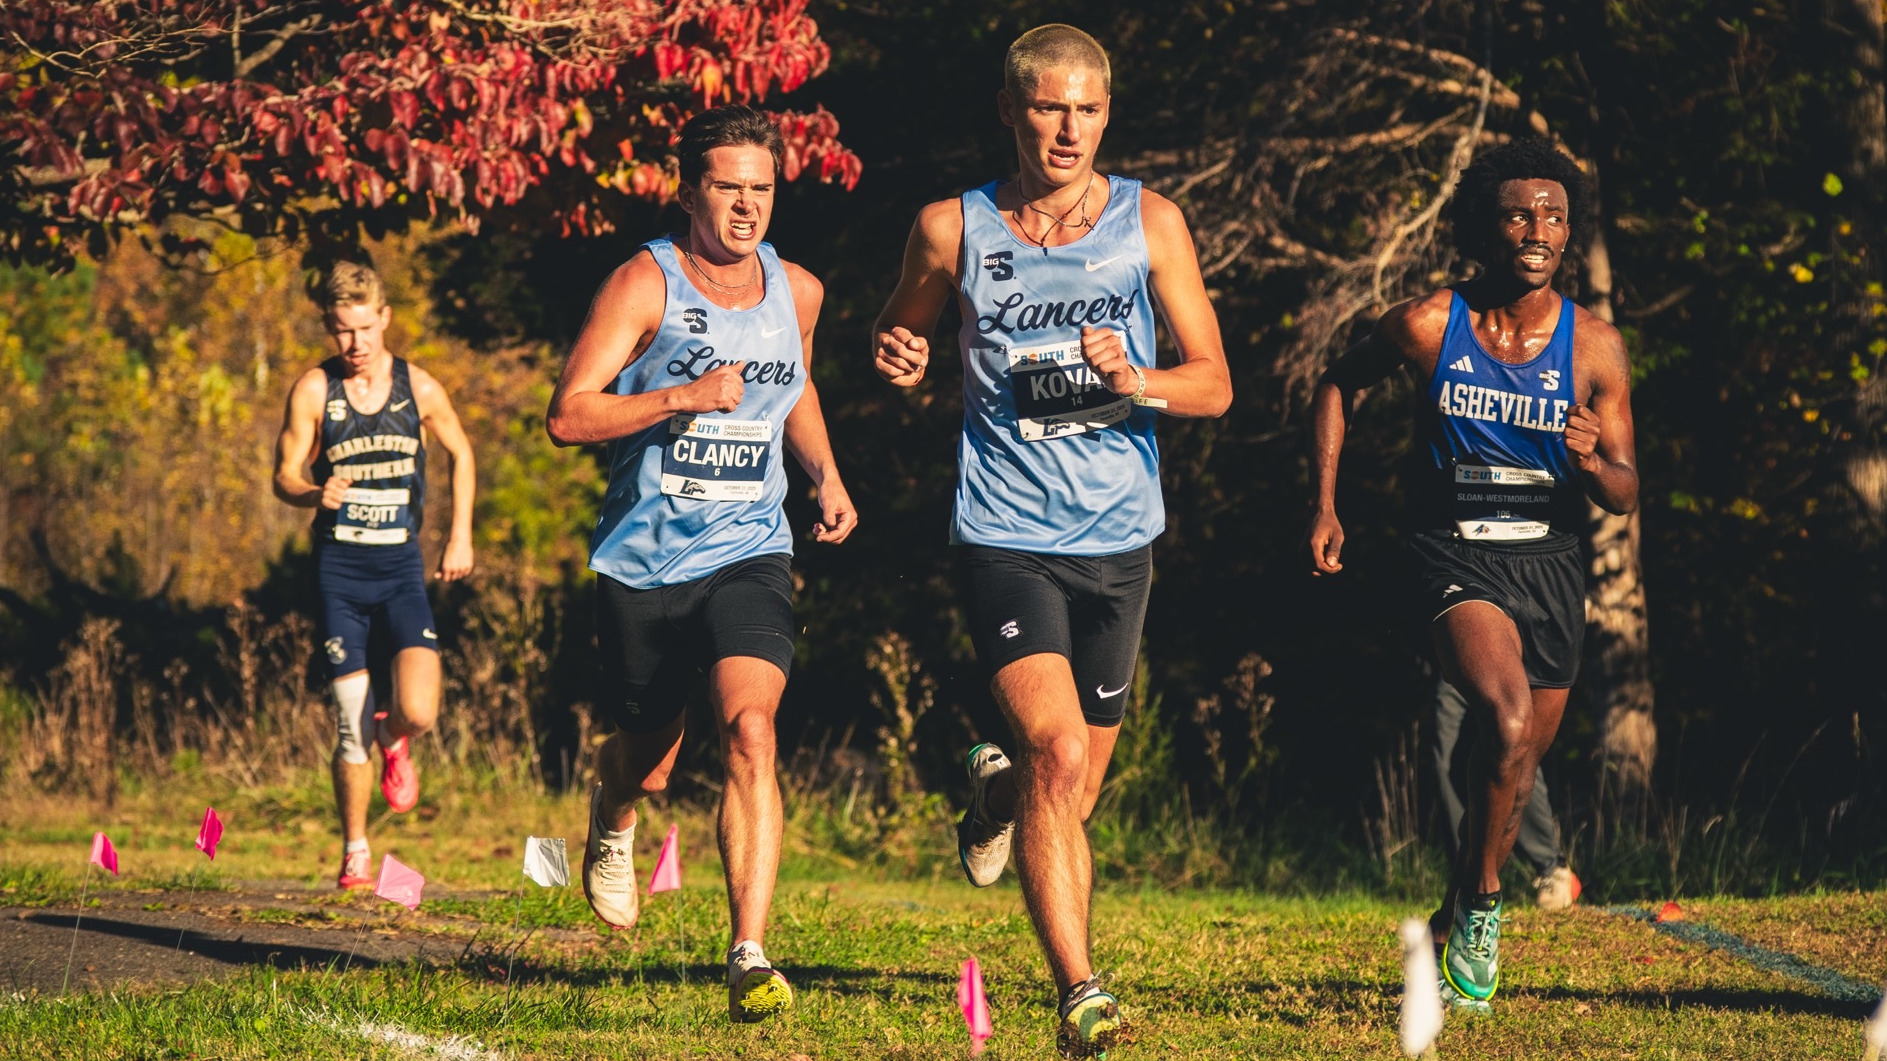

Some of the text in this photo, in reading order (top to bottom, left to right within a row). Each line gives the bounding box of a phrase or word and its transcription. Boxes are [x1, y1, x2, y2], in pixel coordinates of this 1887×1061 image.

[983, 258, 999, 267] BIG
[976, 289, 1139, 335] Lancers
[667, 346, 796, 386] Lacers
[1020, 349, 1065, 366] SOUTH
[1030, 366, 1105, 401] KOVA
[1071, 395, 1083, 407] 14
[1438, 381, 1568, 433] ASHEVILLE
[724, 430, 762, 438] CHAMPIONSHIPS
[673, 439, 765, 468] CLANCY
[714, 467, 721, 476] 6
[1463, 470, 1501, 481] SOUTH
[1457, 492, 1550, 503] SLOAN-WESTMORELAND
[346, 504, 399, 523] SCOTT
